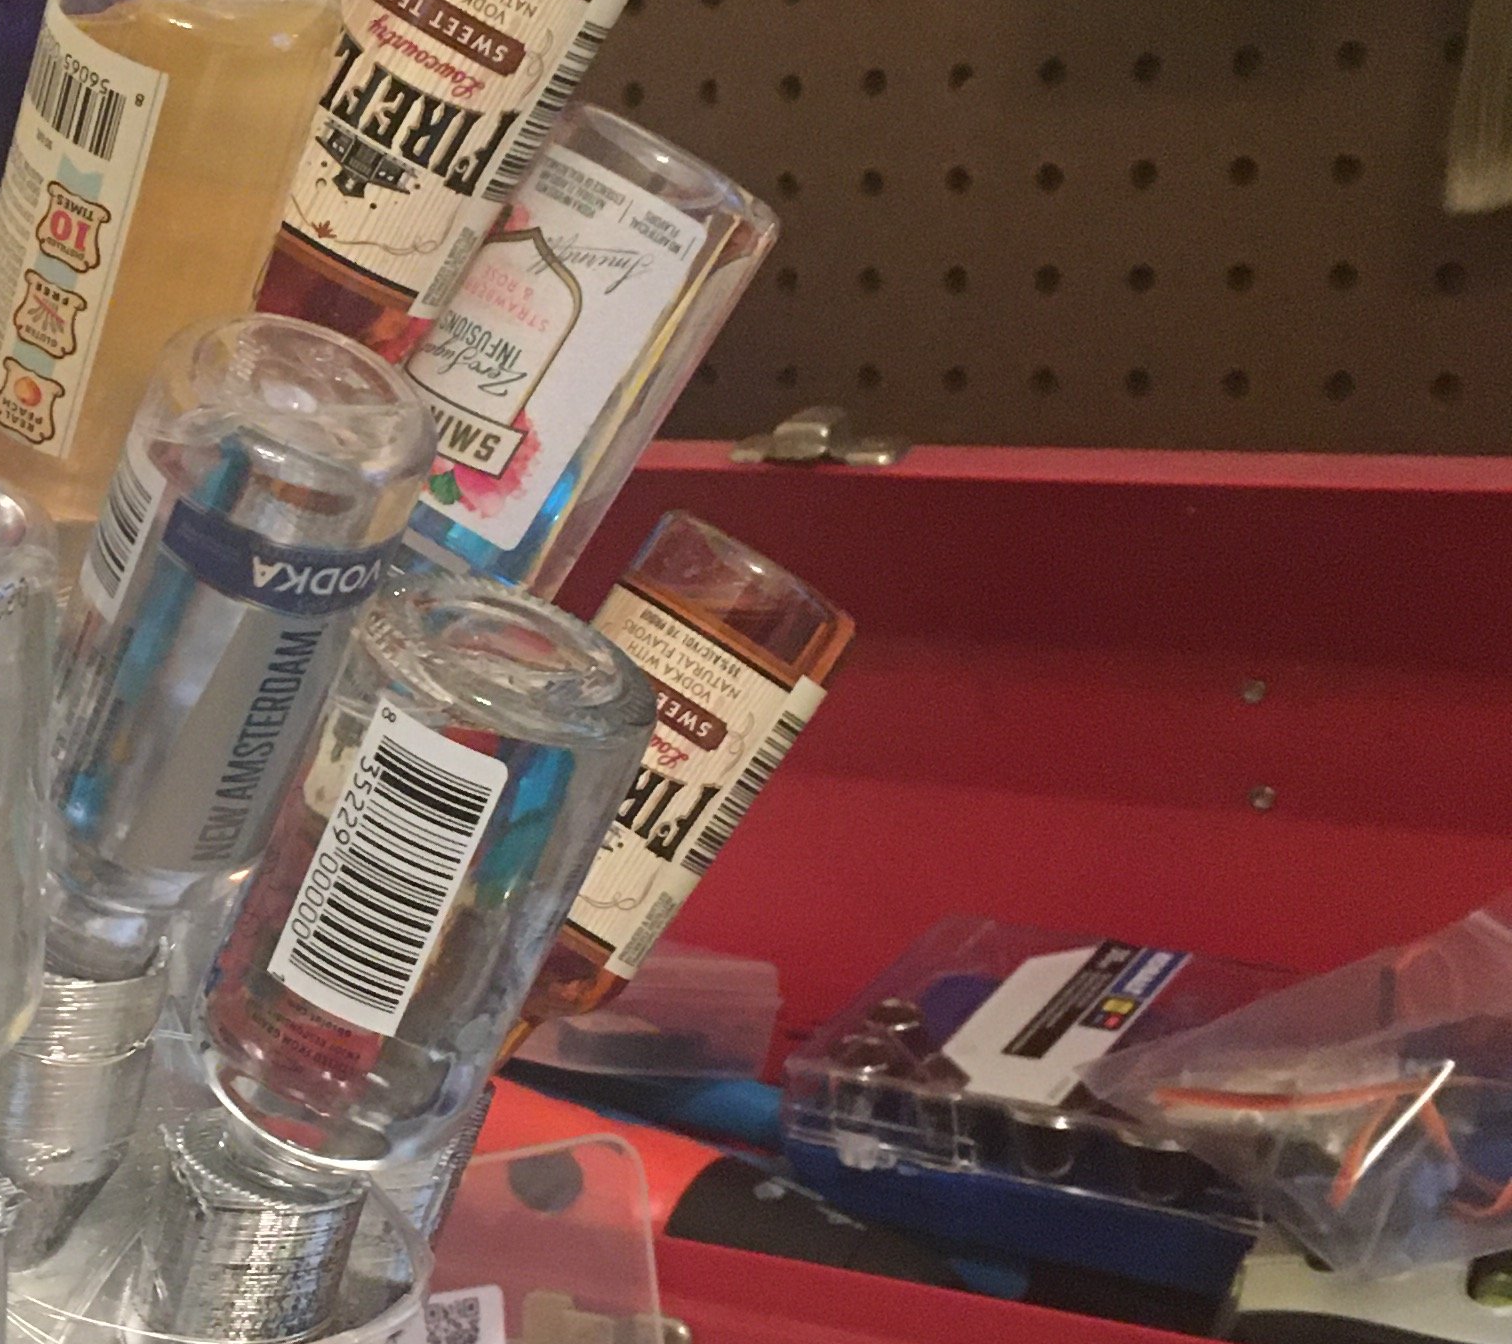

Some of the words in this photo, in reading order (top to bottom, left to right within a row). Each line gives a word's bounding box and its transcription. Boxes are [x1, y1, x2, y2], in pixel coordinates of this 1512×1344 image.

[428, 9, 509, 63] SWEET
[63, 52, 110, 95] 56065
[369, 15, 484, 101] Lowcountry
[135, 93, 145, 107] 8
[318, 31, 521, 198] FIREFL
[56, 194, 94, 222] TIMES
[50, 209, 91, 252] 10
[35, 283, 69, 306] FREE
[463, 278, 549, 332] STRAWBER
[439, 310, 522, 370] INFUSIONS
[467, 357, 528, 397] Zero
[2, 397, 43, 425] PEACH
[5, 409, 35, 433] REAL
[251, 556, 382, 595] VODKA
[623, 619, 676, 657] FLAVORS
[627, 640, 659, 670] WITH
[663, 663, 711, 704] VODKA
[676, 652, 742, 700] NATURAL
[214, 629, 322, 801] AMSTERDAM
[382, 706, 398, 724] 8
[655, 692, 712, 737] SWEE
[331, 753, 381, 842] 35229
[192, 808, 249, 862] NEW
[291, 851, 338, 940] 00000
